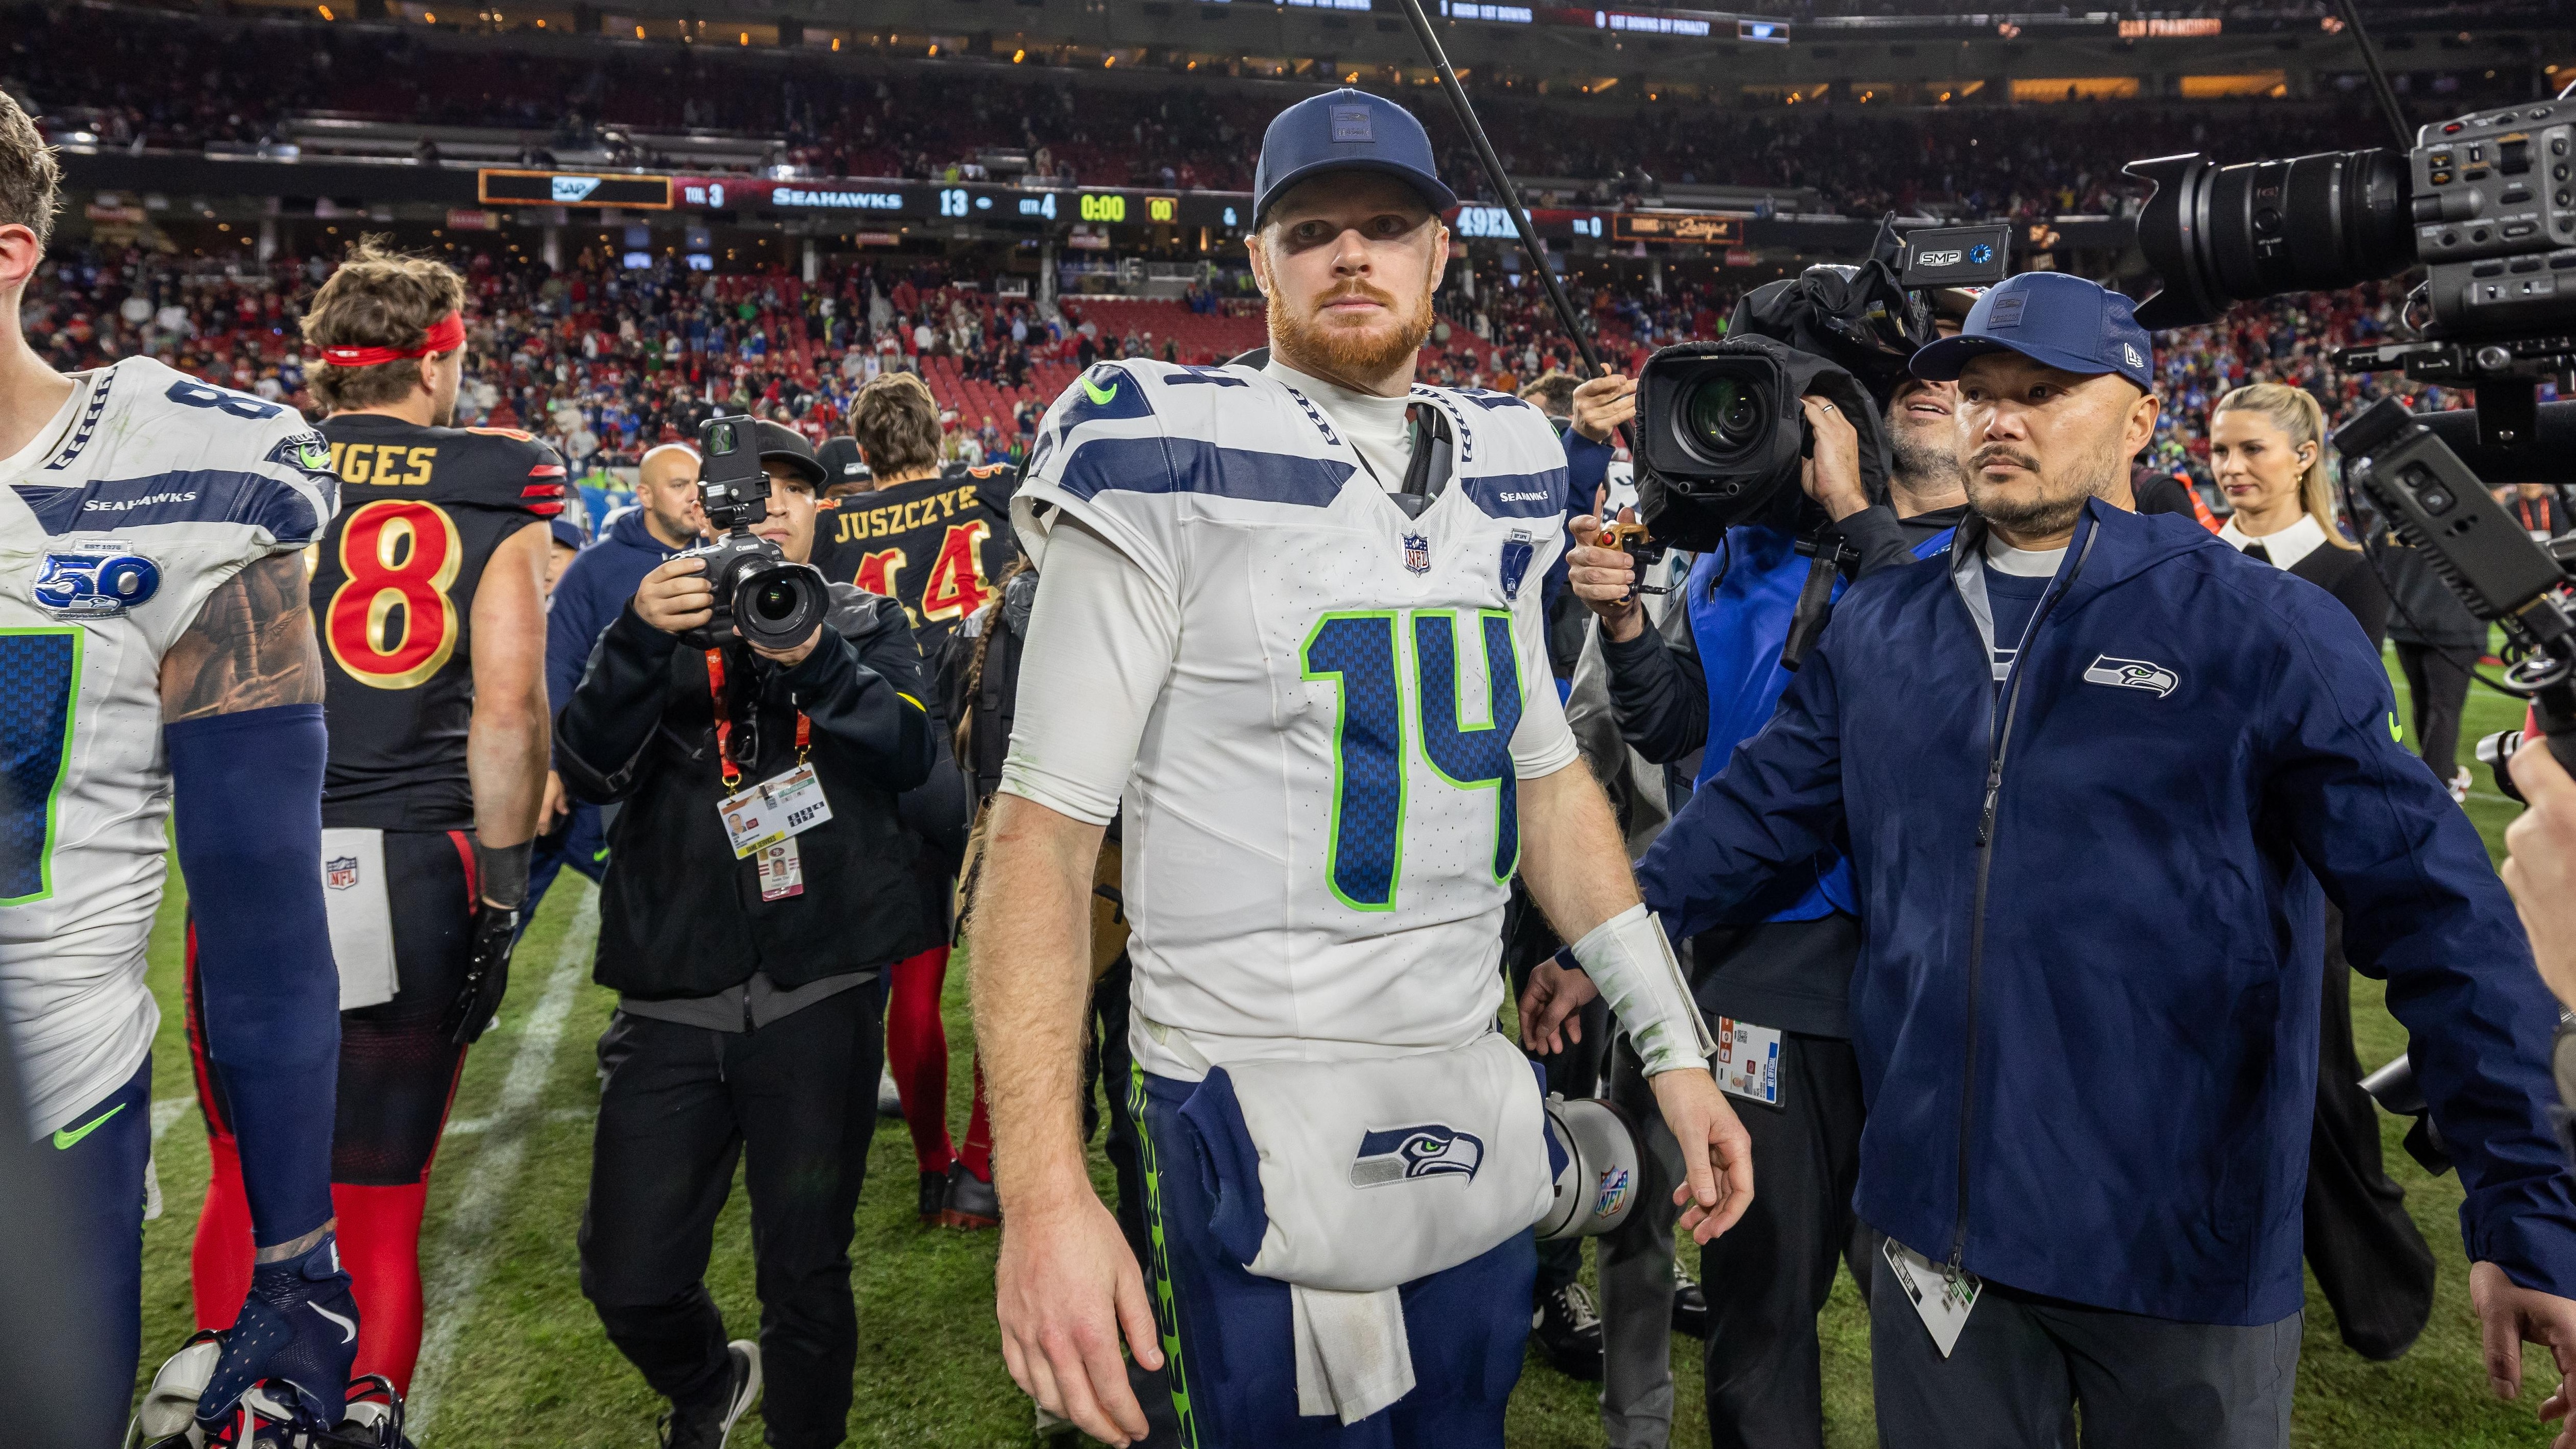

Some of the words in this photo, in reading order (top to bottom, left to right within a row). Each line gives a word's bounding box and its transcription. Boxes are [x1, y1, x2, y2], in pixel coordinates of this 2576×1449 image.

[553, 182, 586, 195] SAP
[709, 183, 724, 208] 3
[772, 187, 903, 209] SEAHAWKS
[940, 189, 969, 217] 13
[1041, 193, 1057, 220] 4
[1081, 194, 1126, 222] 0:00
[1151, 200, 1173, 221] 00
[1590, 216, 1602, 237] 0
[1923, 253, 1958, 263] SMP
[83, 492, 196, 511] SEAHAWKS
[1500, 491, 1548, 502] SEAHAWKS
[835, 485, 978, 543] JUSZCZYK
[736, 543, 759, 552] Canon
[1407, 550, 1429, 568] NFL
[1298, 610, 1526, 912] 14
[330, 870, 354, 885] NFL
[1904, 1272, 1915, 1292] TEAM
